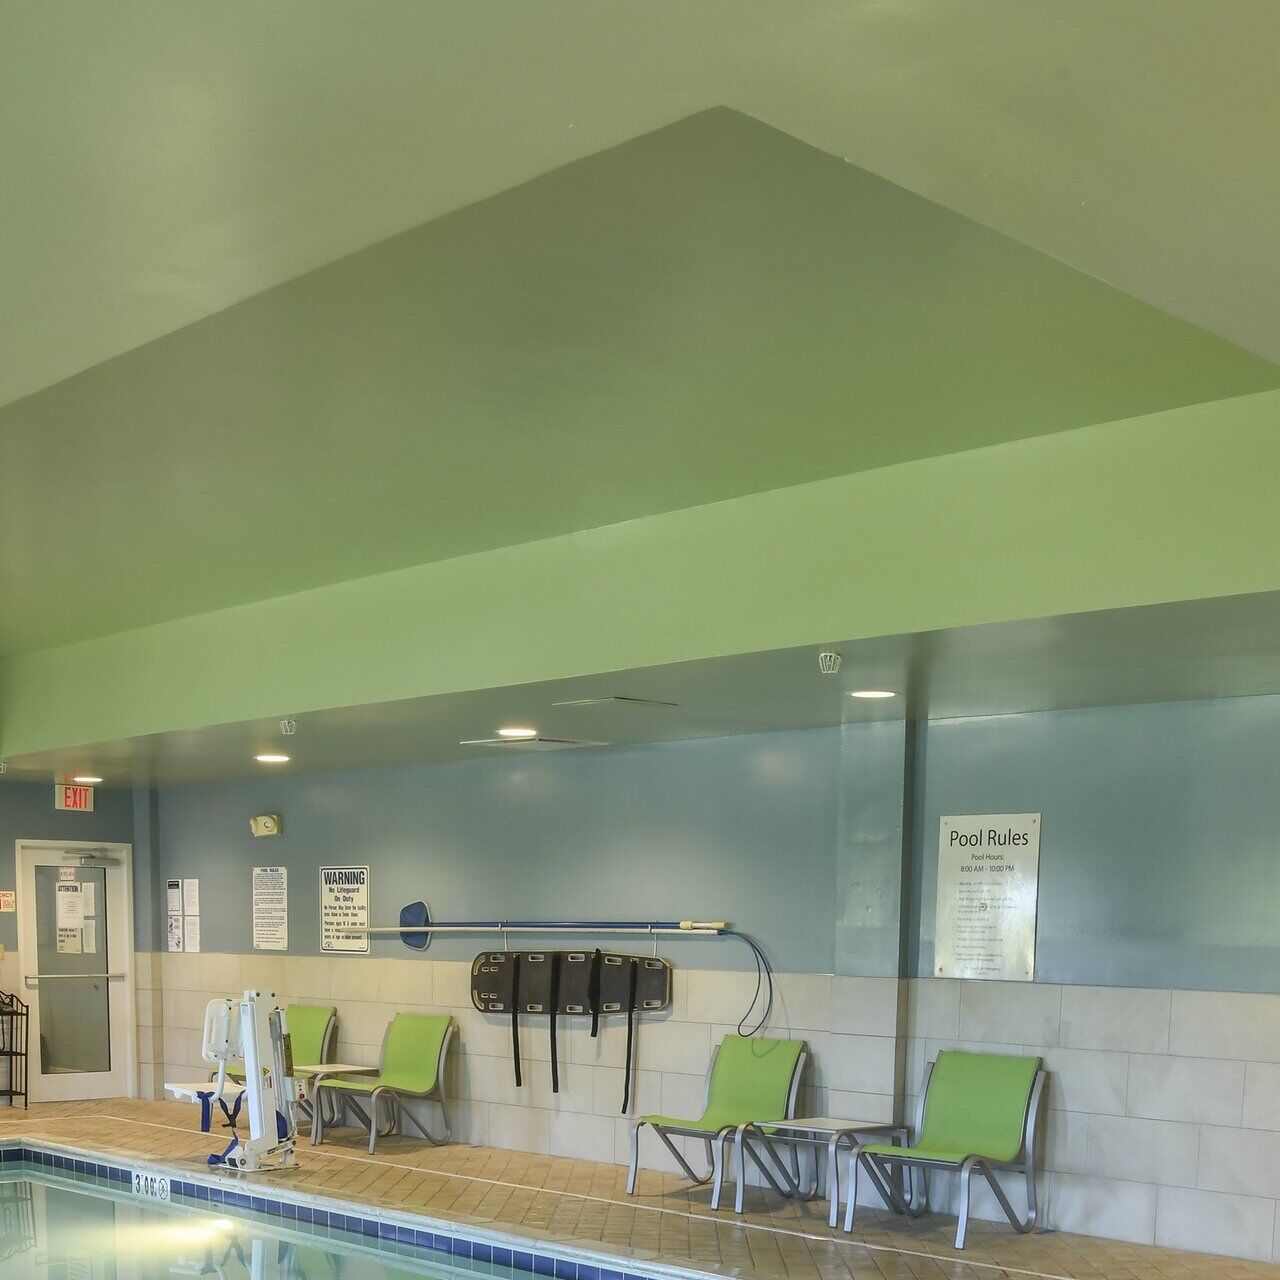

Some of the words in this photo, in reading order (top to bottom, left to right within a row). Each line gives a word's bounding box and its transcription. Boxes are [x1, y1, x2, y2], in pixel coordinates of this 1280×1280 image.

[64, 786, 89, 808] EXIT
[950, 830, 982, 847] Pool
[988, 828, 1029, 846] Rules
[324, 871, 365, 885] WARNING
[58, 885, 79, 893] ATTENTION
[337, 887, 360, 895] Lifeguard
